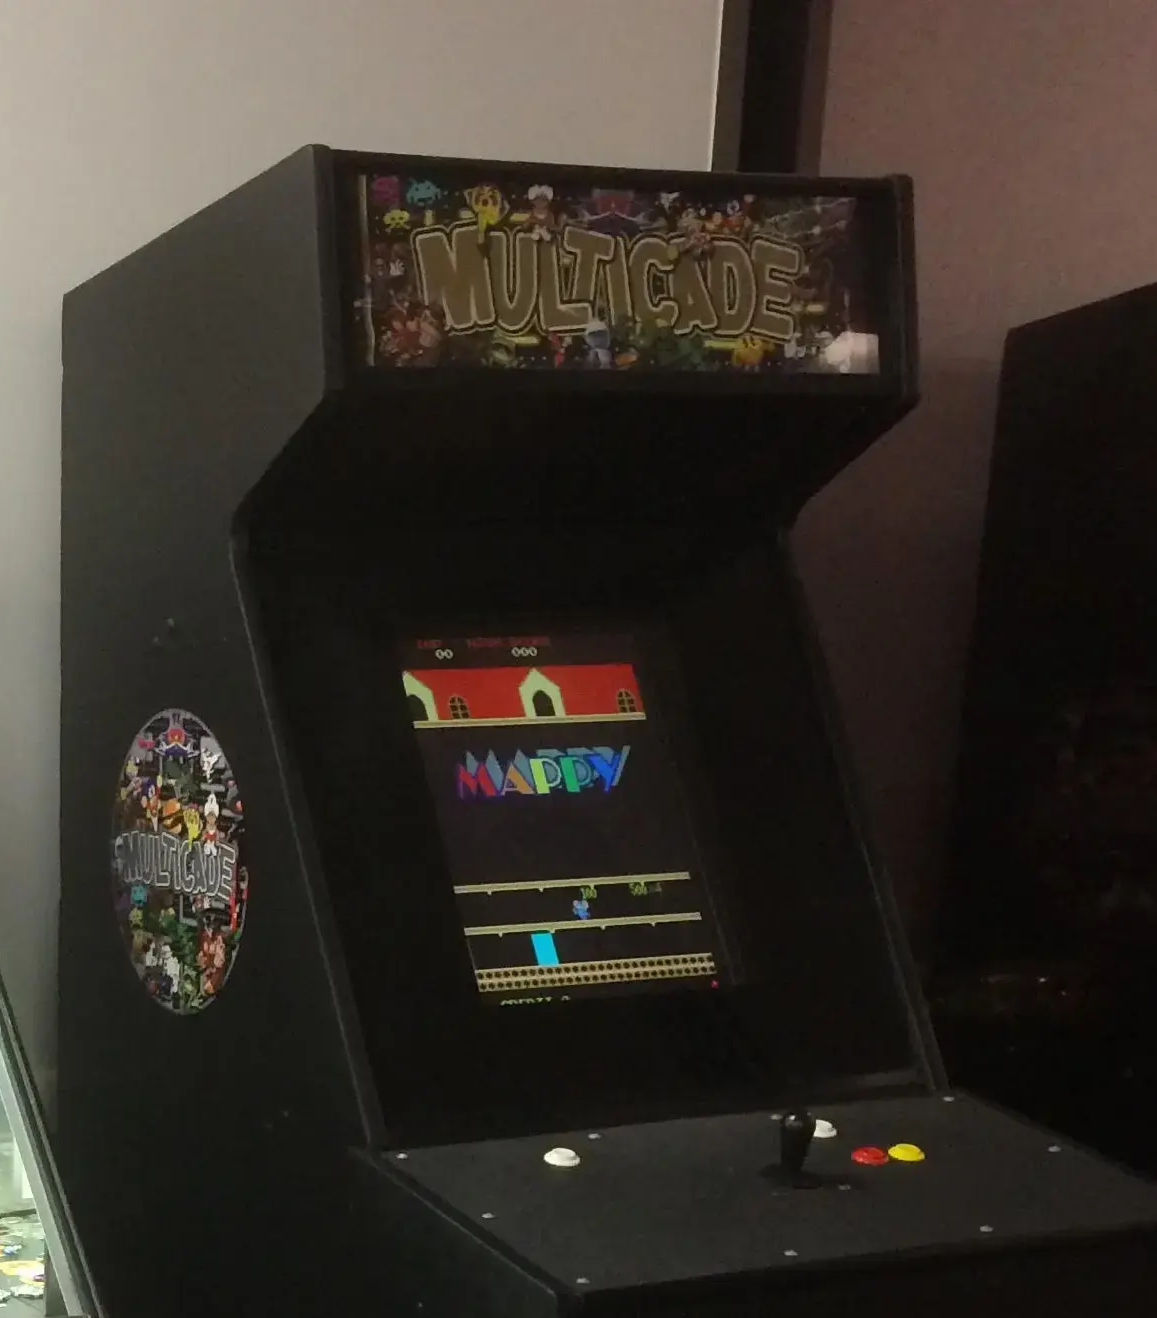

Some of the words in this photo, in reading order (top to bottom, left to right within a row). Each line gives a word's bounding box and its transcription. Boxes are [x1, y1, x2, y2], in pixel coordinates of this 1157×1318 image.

[414, 220, 804, 341] MULTICADE
[456, 745, 631, 799] MAPPY
[117, 830, 237, 900] MULTICADE
